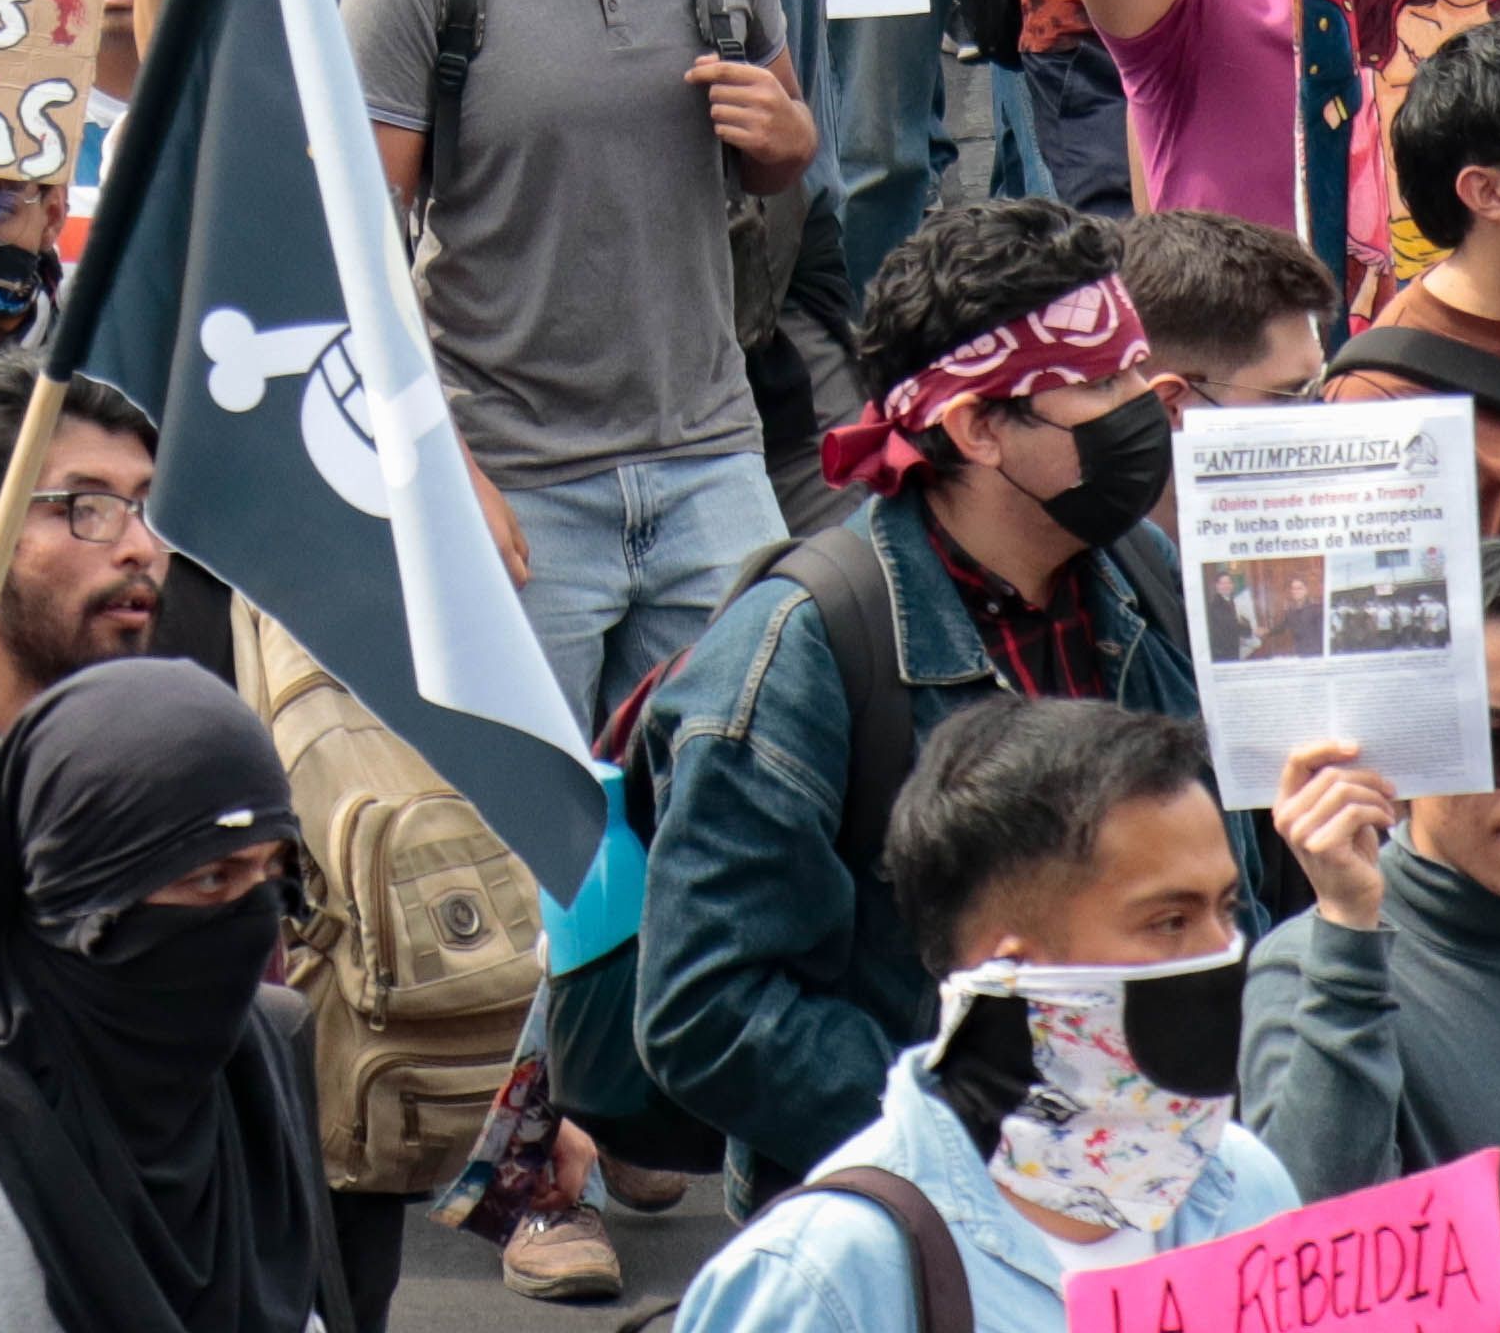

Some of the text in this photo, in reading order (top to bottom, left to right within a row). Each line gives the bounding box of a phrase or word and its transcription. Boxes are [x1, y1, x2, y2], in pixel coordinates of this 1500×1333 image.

[1205, 438, 1401, 473] ANTIIMPERIALISTA
[1210, 483, 1426, 514] ¿Quién puede detener a Trump?
[1234, 514, 1280, 535] lucha
[1285, 512, 1339, 531] obrera
[1343, 515, 1352, 532] y
[1355, 505, 1444, 529] campesina
[1229, 526, 1413, 556] en defensa de México!
[1235, 1189, 1483, 1333] REBELDÍA
